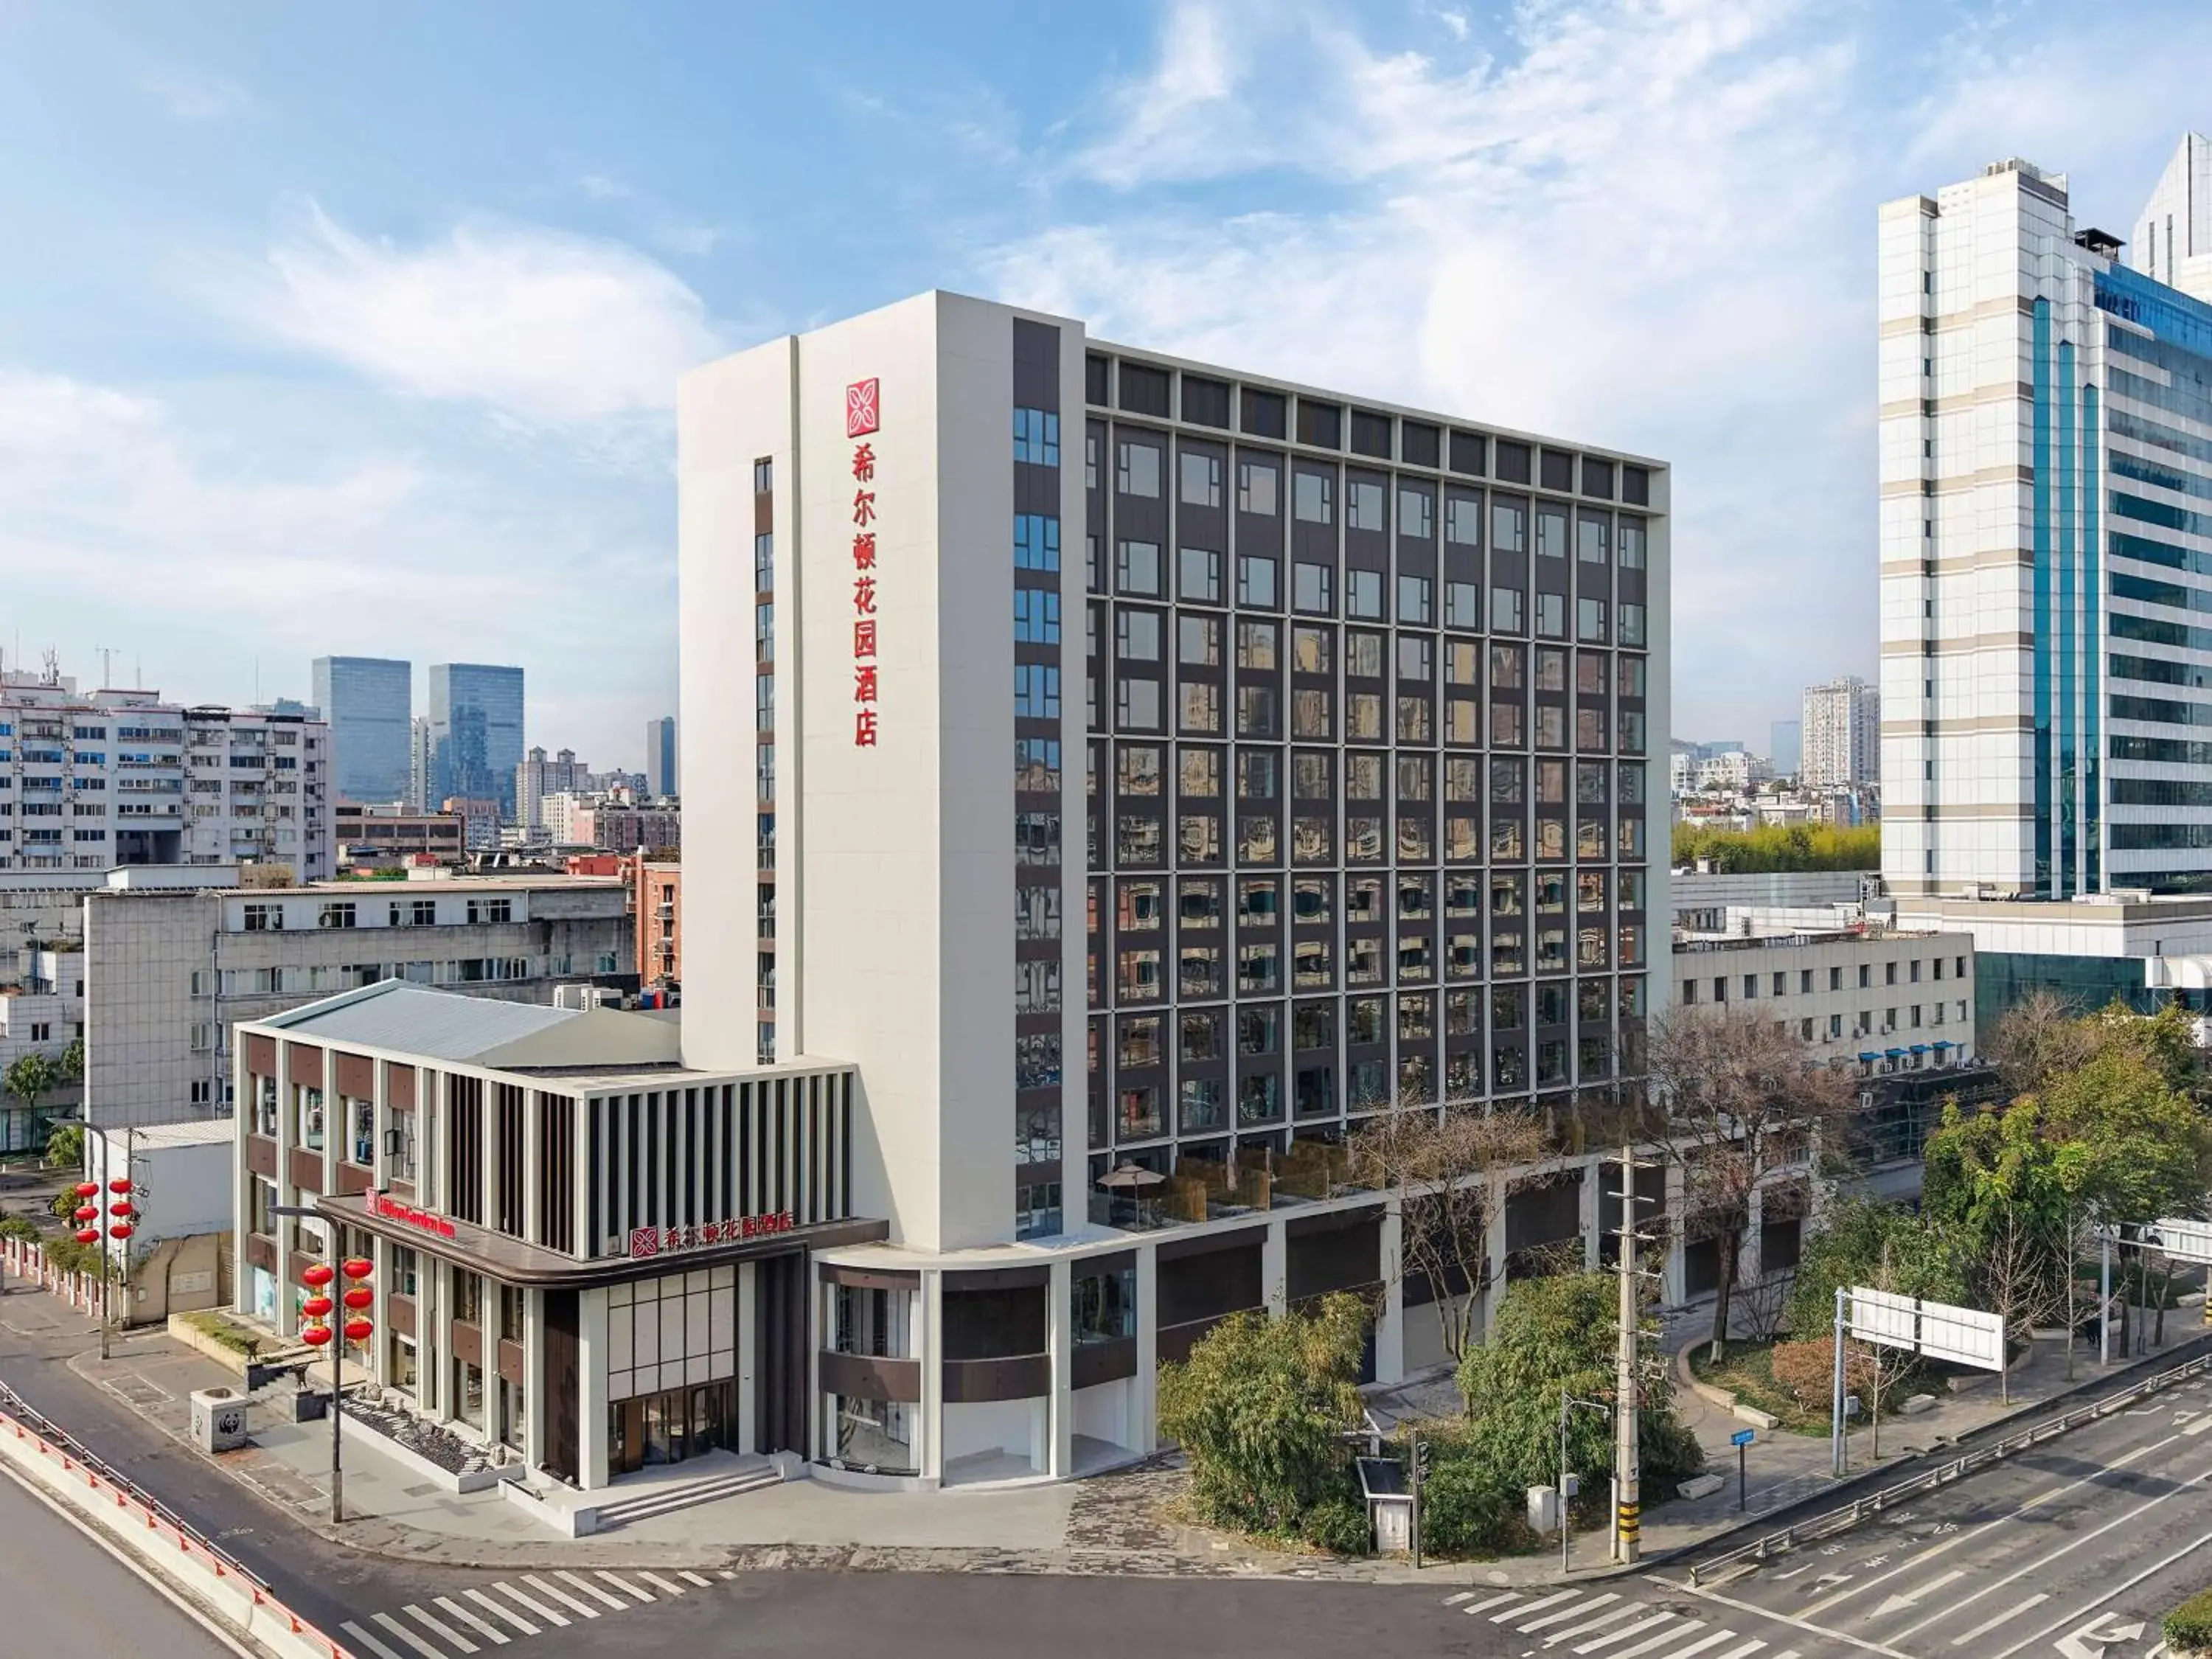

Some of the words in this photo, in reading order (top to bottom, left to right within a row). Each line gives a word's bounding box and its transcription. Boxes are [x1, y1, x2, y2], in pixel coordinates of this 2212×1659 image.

[852, 443, 877, 746] 希尔顿花园酒店
[664, 1210, 793, 1248] 希尔顿花园酒店
